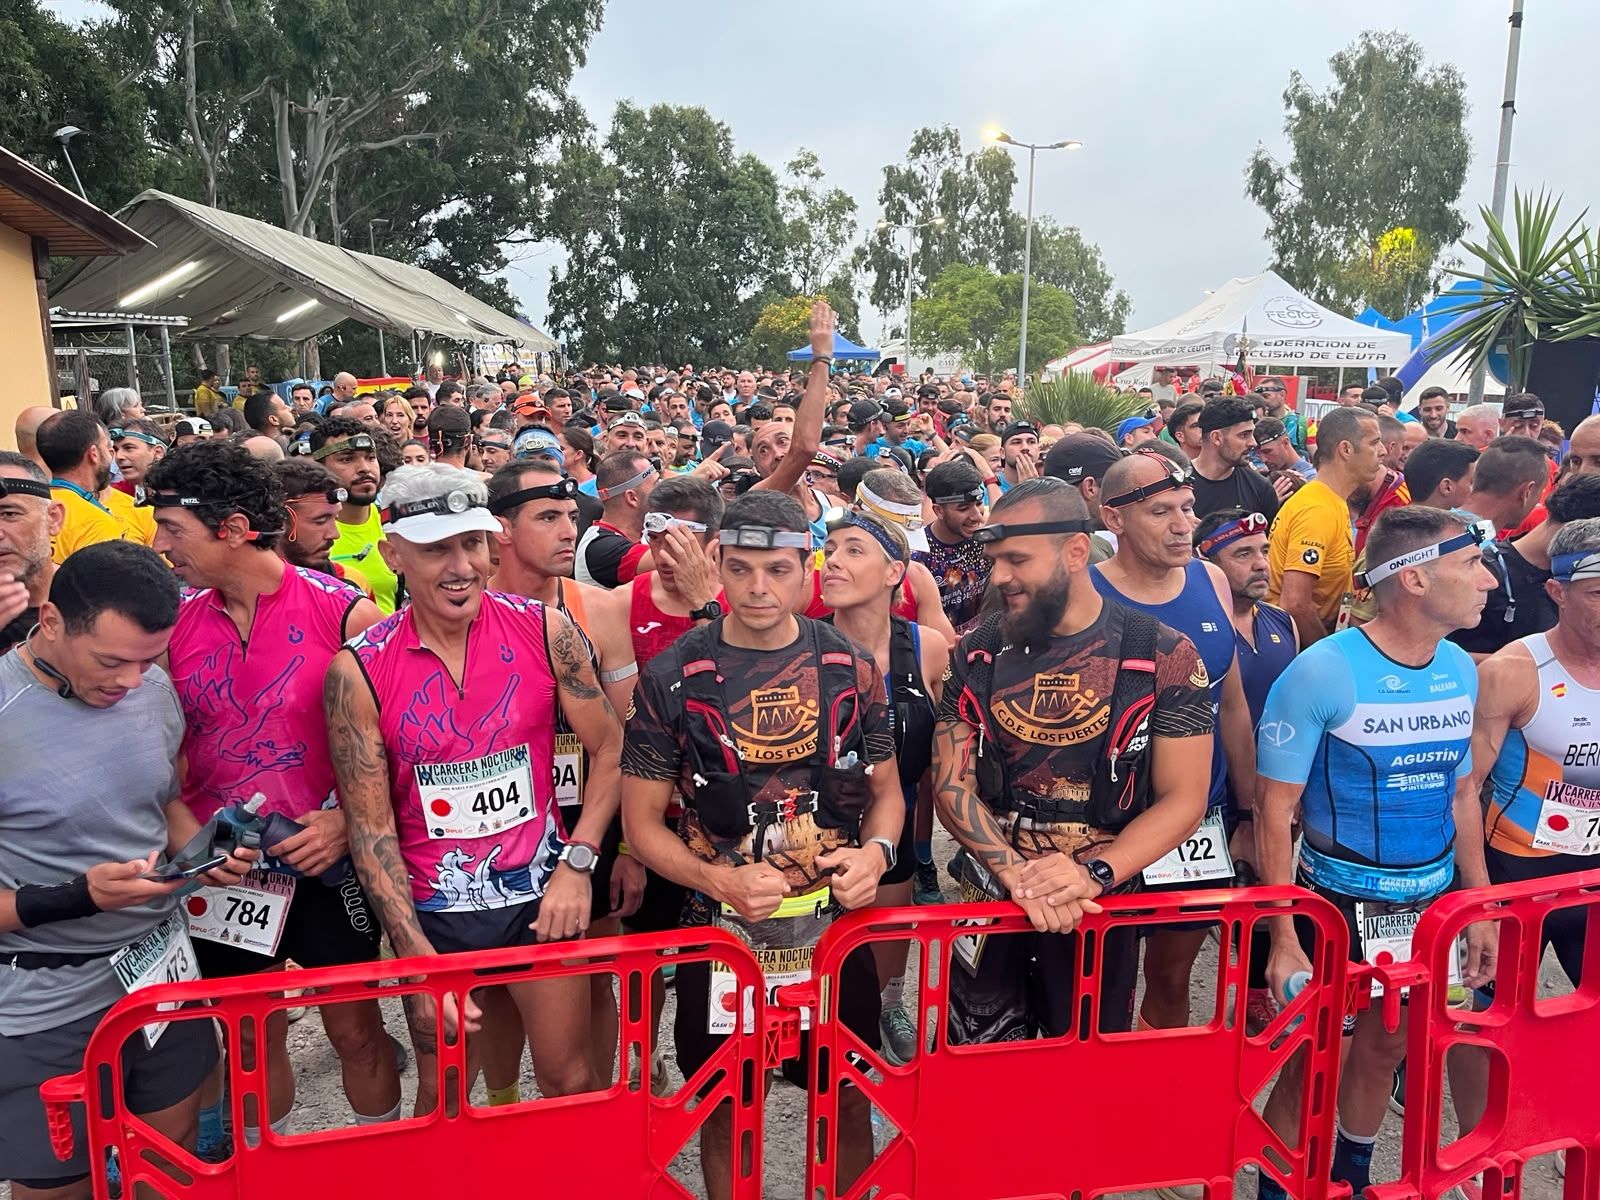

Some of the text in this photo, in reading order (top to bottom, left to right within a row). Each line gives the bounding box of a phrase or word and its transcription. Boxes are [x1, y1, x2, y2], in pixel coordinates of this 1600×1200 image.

[1188, 344, 1211, 353] CEUTA
[1263, 339, 1377, 349] EDERACION DE
[1310, 351, 1329, 360] DE
[1336, 352, 1386, 361] CEUTA
[1115, 376, 1149, 387] Cruz Roja
[1389, 548, 1435, 571] ONNIGHT
[997, 708, 1027, 737] C.D.E.
[1363, 710, 1471, 735] SAN URBANO
[555, 734, 582, 747] TURNA
[755, 750, 783, 760] LOS
[1391, 748, 1459, 767] AGUSTÍN
[1563, 742, 1600, 767] BER
[416, 744, 528, 787] IX CARRERA NOCTURNA
[481, 769, 496, 780] DE
[1408, 781, 1445, 791] INTERSPORT
[1546, 780, 1600, 803] IX CARRER
[472, 780, 520, 816] 404
[1586, 817, 1600, 838] 7
[246, 869, 294, 888] NOCURNA
[1380, 877, 1416, 889] CARRERA
[225, 896, 271, 930] 784
[1366, 913, 1417, 940] IX CARRERA
[116, 959, 139, 988] IX
[128, 931, 161, 968] CARRERA
[166, 945, 189, 983] 473
[779, 947, 816, 964] NOCTUR
